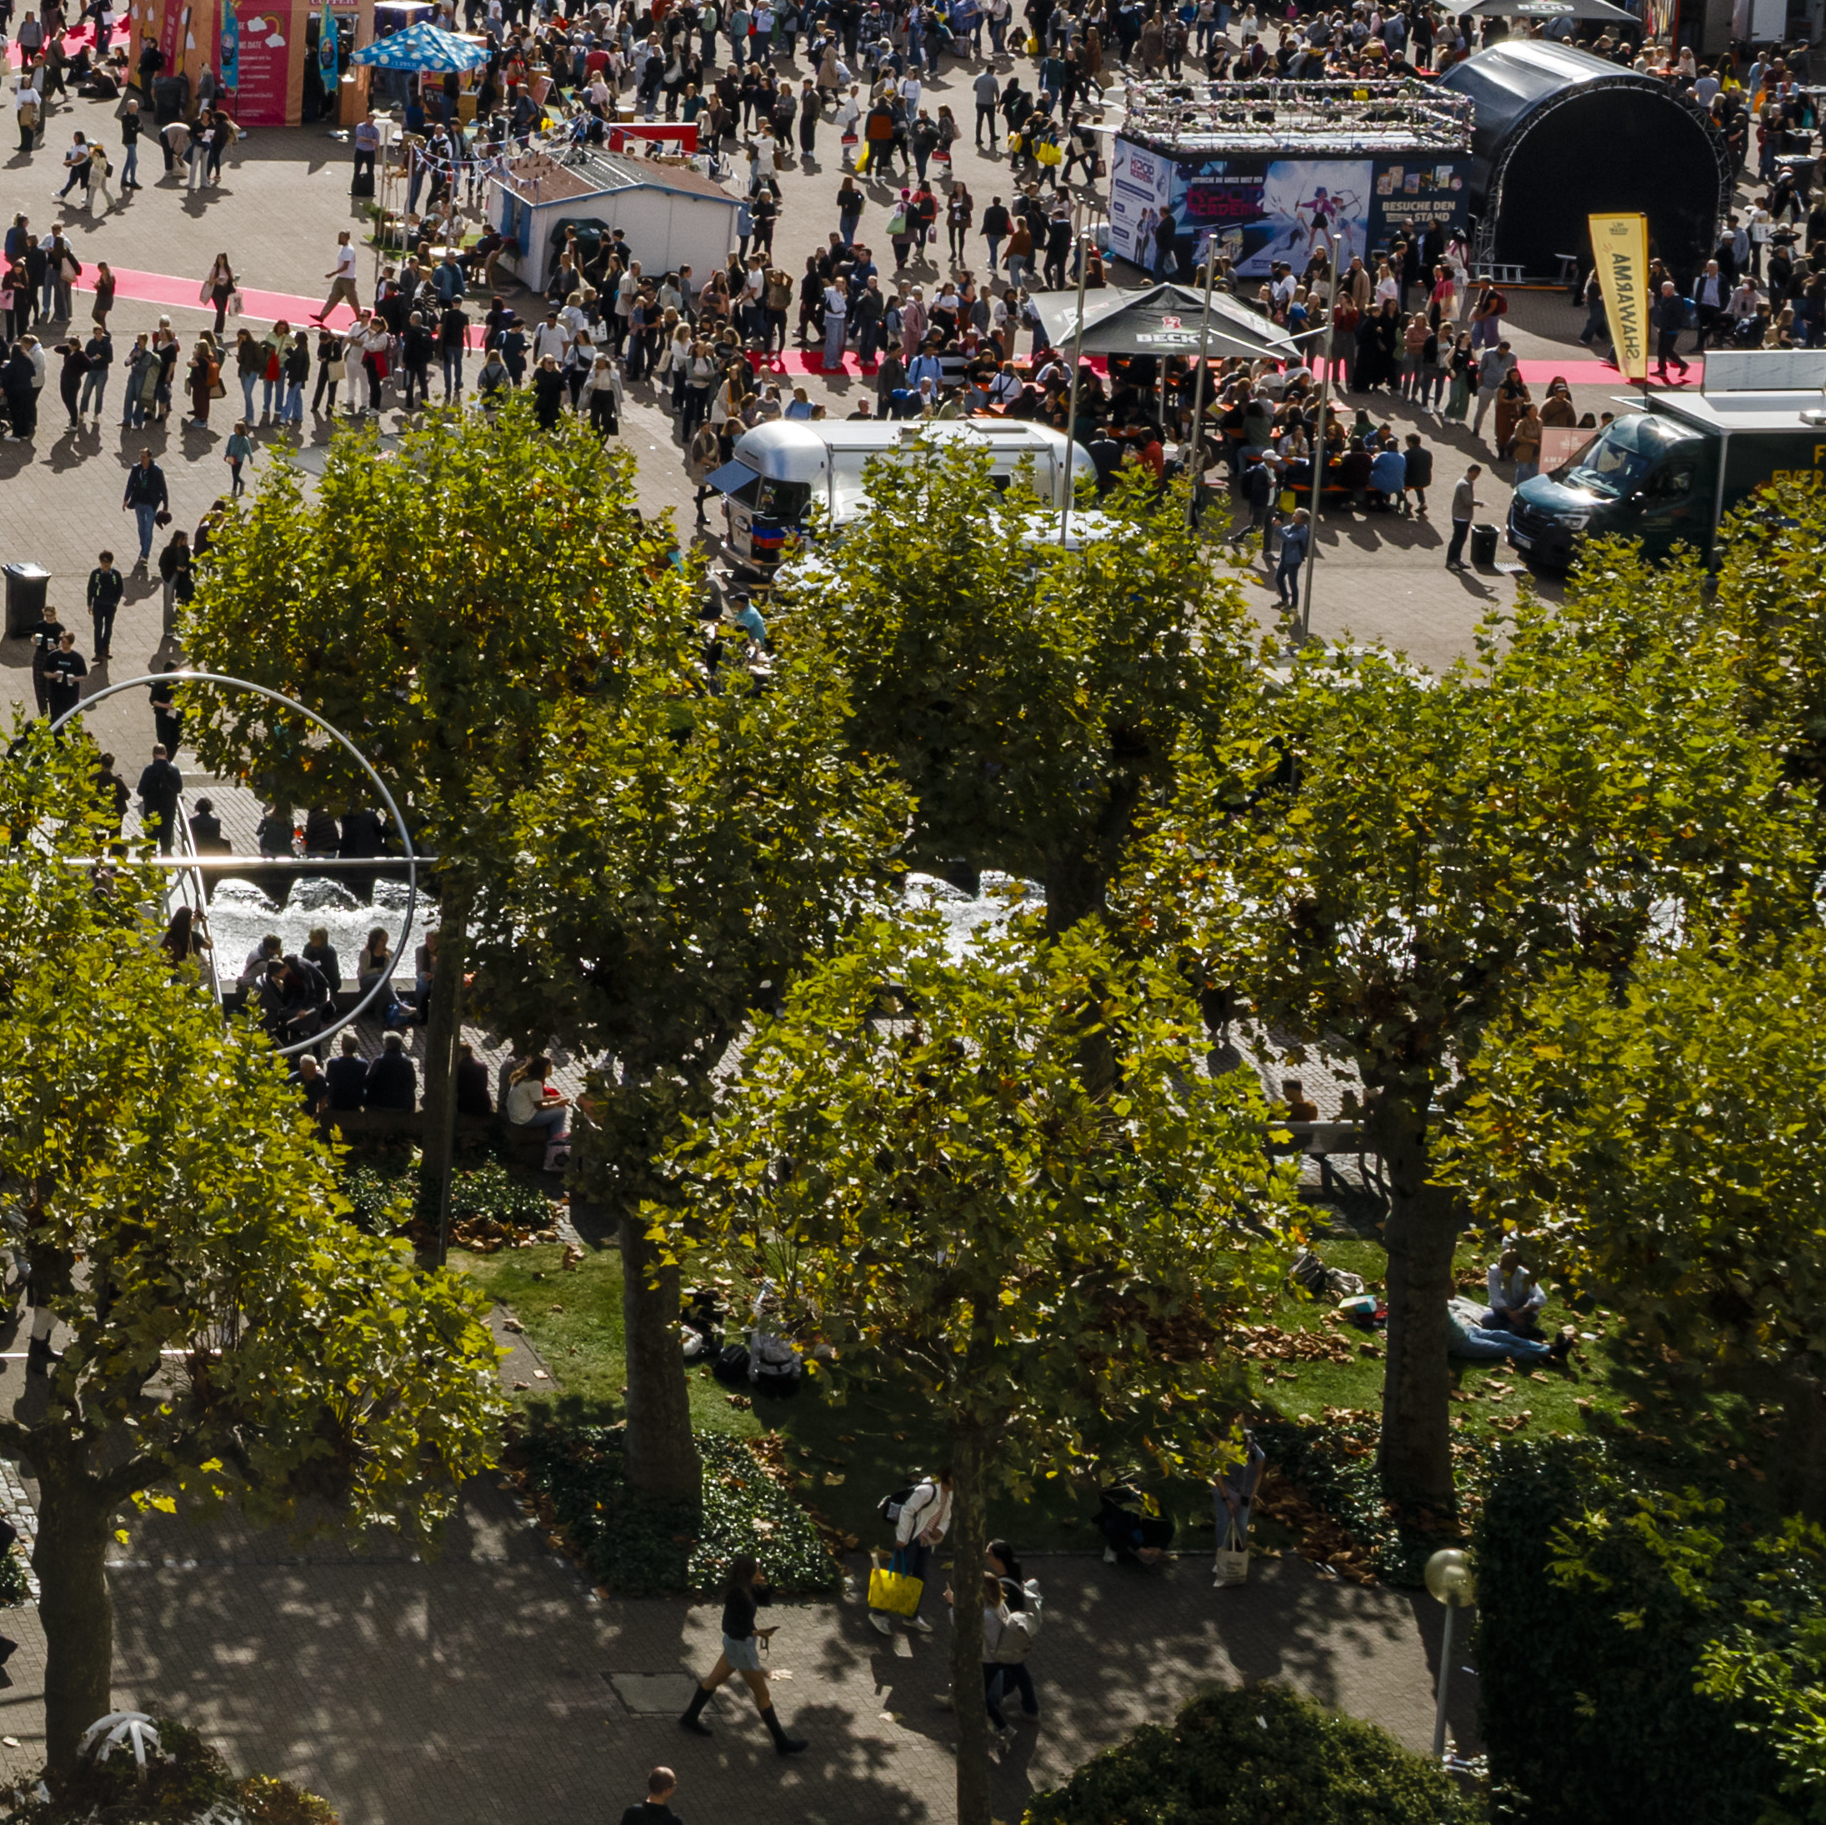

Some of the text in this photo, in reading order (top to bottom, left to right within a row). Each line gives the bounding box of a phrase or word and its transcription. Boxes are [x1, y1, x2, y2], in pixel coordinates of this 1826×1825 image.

[1382, 201, 1456, 212] BESUCHE DEN
[1414, 212, 1450, 222] STAND
